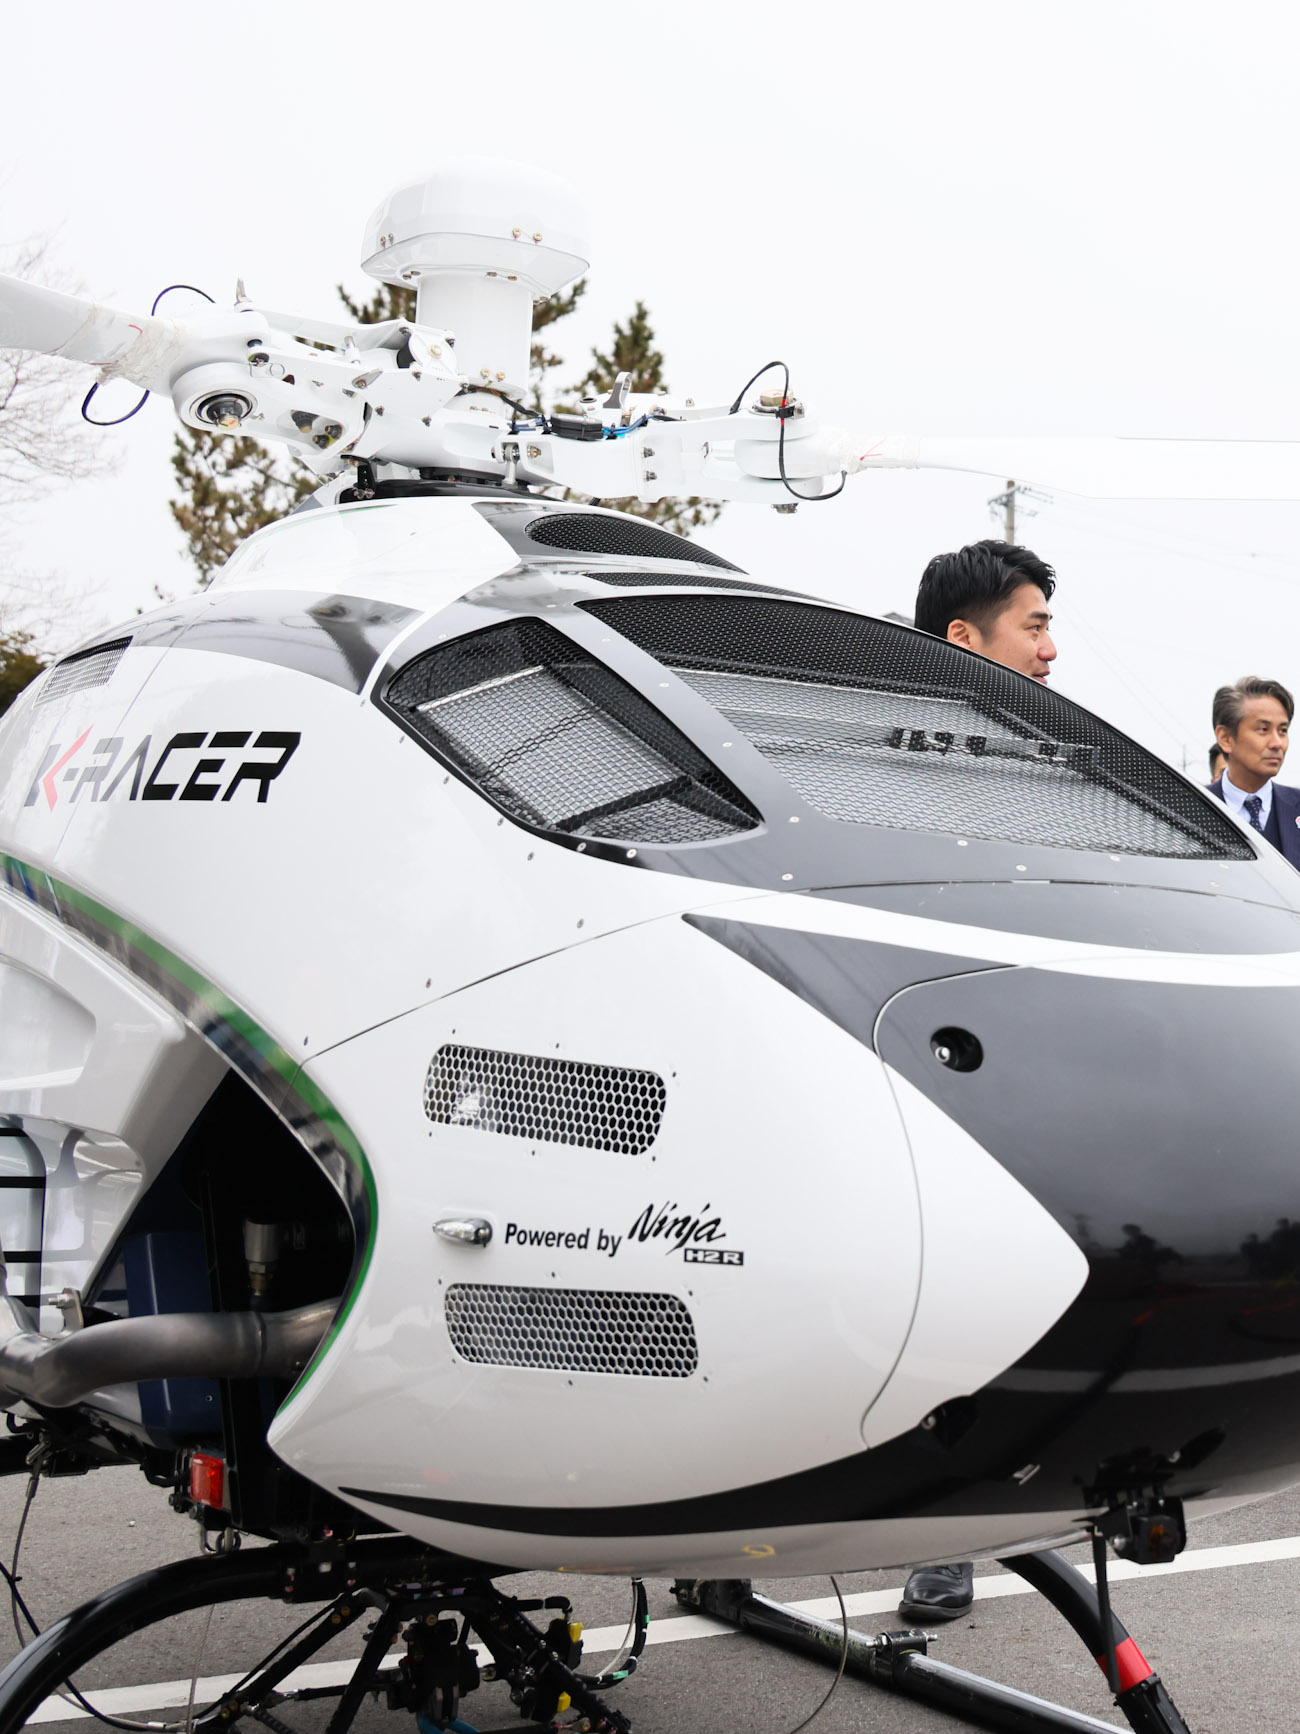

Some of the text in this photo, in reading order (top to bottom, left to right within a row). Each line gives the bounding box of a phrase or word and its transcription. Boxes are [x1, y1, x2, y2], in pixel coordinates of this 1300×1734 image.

[24, 724, 302, 811] K-RACER
[505, 1201, 726, 1257] Powered by Ninja
[685, 1249, 743, 1265] H2R
